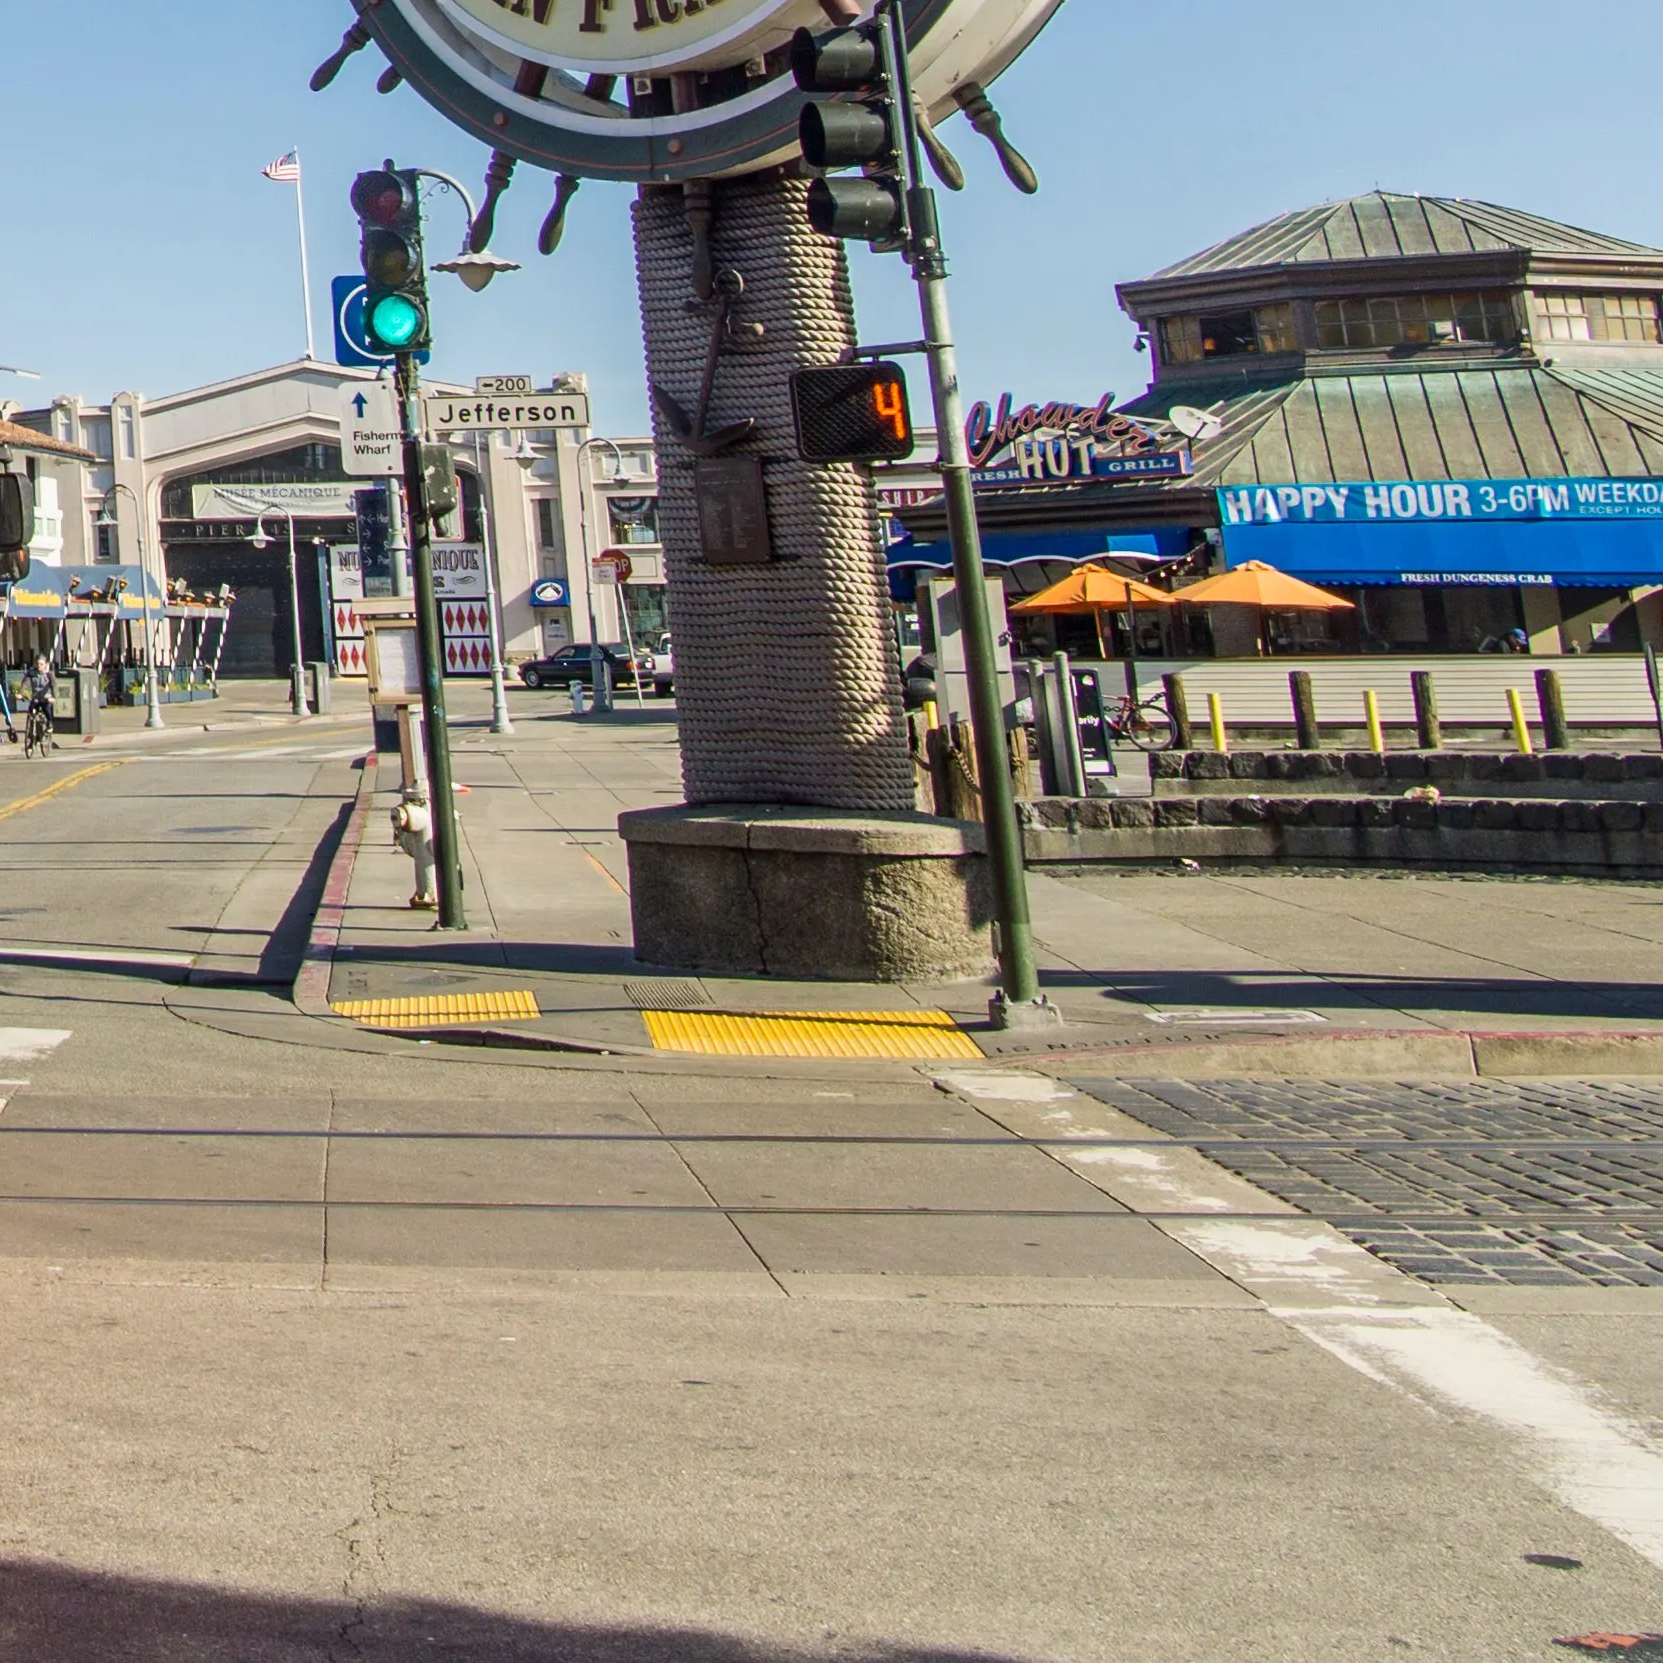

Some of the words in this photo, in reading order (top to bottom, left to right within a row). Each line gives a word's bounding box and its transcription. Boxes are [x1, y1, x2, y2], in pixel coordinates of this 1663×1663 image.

[495, 377, 526, 391] 200
[439, 403, 575, 424] Jefferson
[874, 381, 906, 440] 4
[965, 391, 1156, 466] Chowder
[354, 443, 391, 455] Wharf
[1015, 435, 1096, 479] HUT
[971, 469, 1021, 482] RESH
[1108, 457, 1175, 473] GRILL
[1225, 486, 1350, 523] HAPPY
[1364, 484, 1472, 519] HOUR
[1479, 484, 1570, 513] 3-6PM
[1574, 482, 1663, 503] WEEKD
[1579, 505, 1630, 514] EXCEPT
[195, 524, 246, 537] PIER
[1401, 573, 1440, 583] FRESH
[1442, 573, 1517, 583] DUNGENESS
[1518, 573, 1554, 583] CRAB
